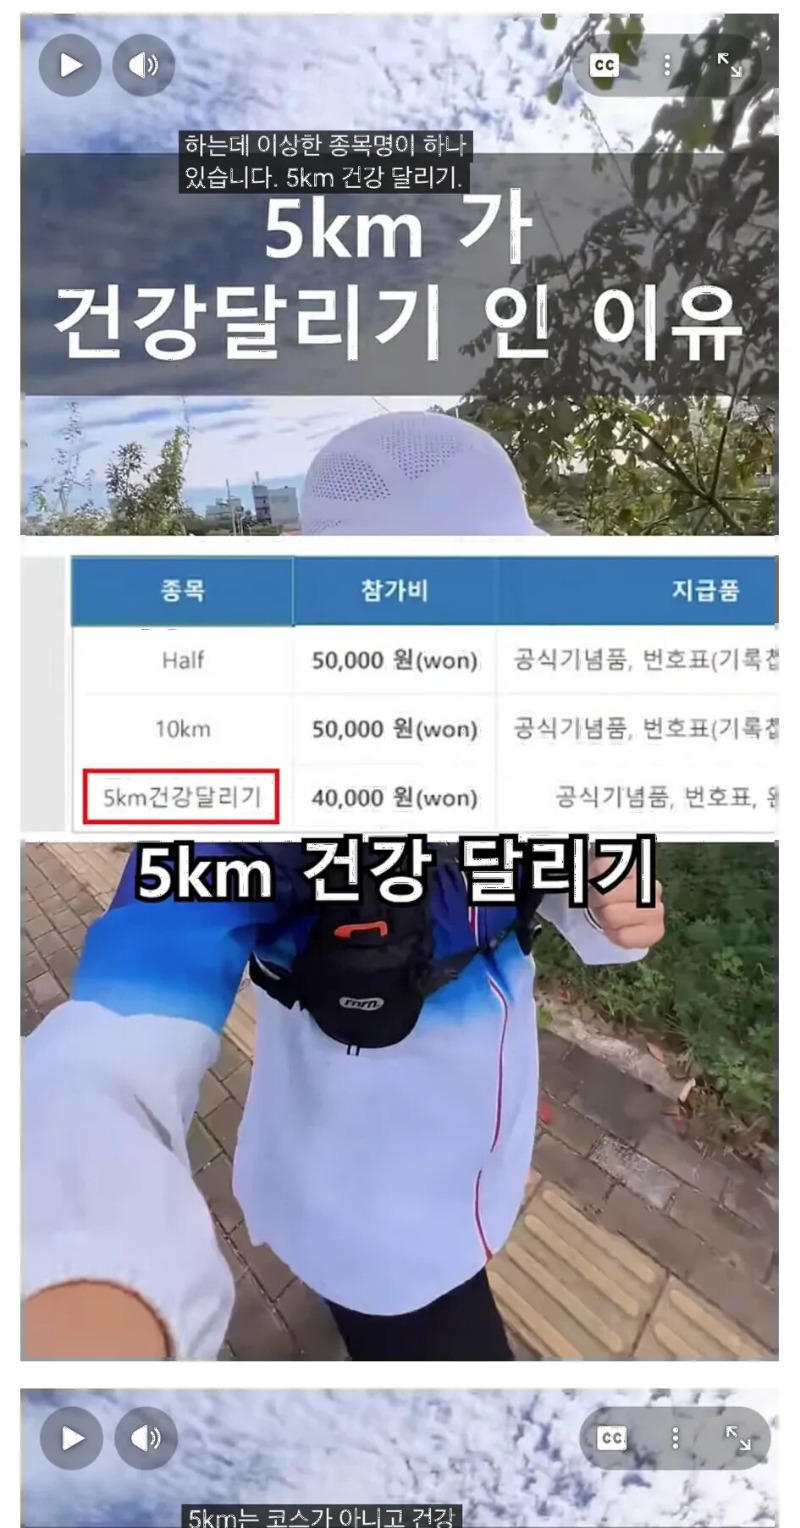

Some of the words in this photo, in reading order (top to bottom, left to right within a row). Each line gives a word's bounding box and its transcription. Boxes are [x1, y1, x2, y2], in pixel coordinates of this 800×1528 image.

[160, 577, 206, 604] 종목
[360, 578, 429, 603] 참가비
[672, 579, 741, 603] 지급품
[162, 650, 205, 670] Half
[311, 649, 385, 674] 50,000
[392, 648, 479, 674] 원(won)
[513, 647, 633, 673] 공식기념품,
[155, 719, 212, 740] 10km
[311, 719, 385, 743] 50,000
[392, 717, 479, 743] 원(won)
[513, 716, 633, 742] 공식기념품,
[102, 785, 262, 811] 5km건강달리기
[311, 788, 385, 811] 40,000
[392, 786, 479, 811] 원(won)
[555, 785, 675, 811] 공식기념품,
[685, 785, 757, 811] 번호표,
